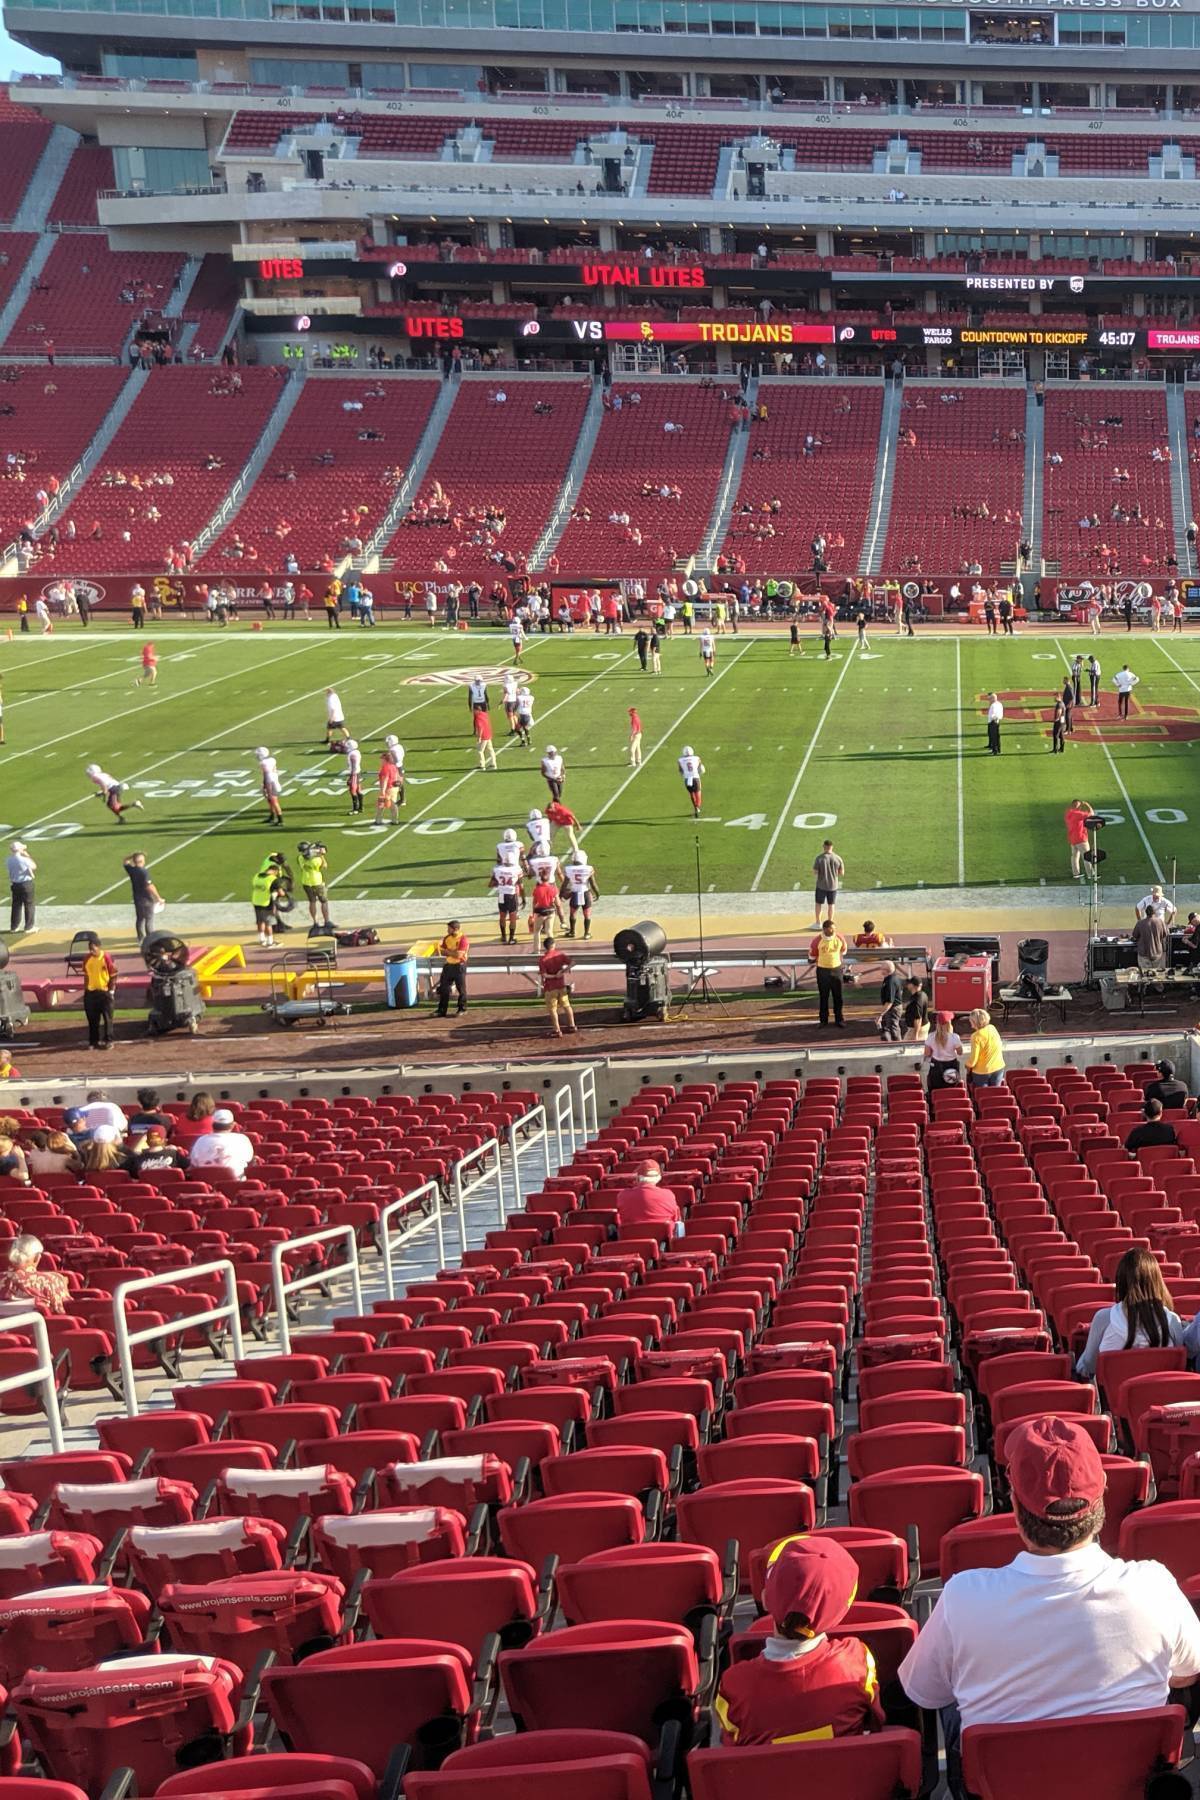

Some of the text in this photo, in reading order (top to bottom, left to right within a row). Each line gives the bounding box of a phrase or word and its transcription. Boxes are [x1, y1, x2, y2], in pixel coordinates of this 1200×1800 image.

[953, 118, 968, 127] 406
[1088, 121, 1103, 130] 407
[261, 260, 303, 280] UTES
[583, 265, 705, 288] UTAH UTES
[966, 278, 1032, 290] PRESENTED
[1037, 278, 1054, 291] BY
[407, 317, 463, 338] UTES
[573, 321, 603, 339] VS
[699, 323, 793, 343] TROJANS
[923, 328, 952, 337] WELLS
[871, 330, 897, 341] UTES
[924, 337, 953, 345] FARGO
[961, 331, 1088, 344] COUNTDOWN TO KICKOFF
[1099, 332, 1136, 345] 45:07
[1156, 334, 1200, 345] TROJANS
[724, 811, 838, 831] 40
[179, 1593, 287, 1612] www.trojanseats.com
[40, 1678, 174, 1704] www.trojanseats.com
